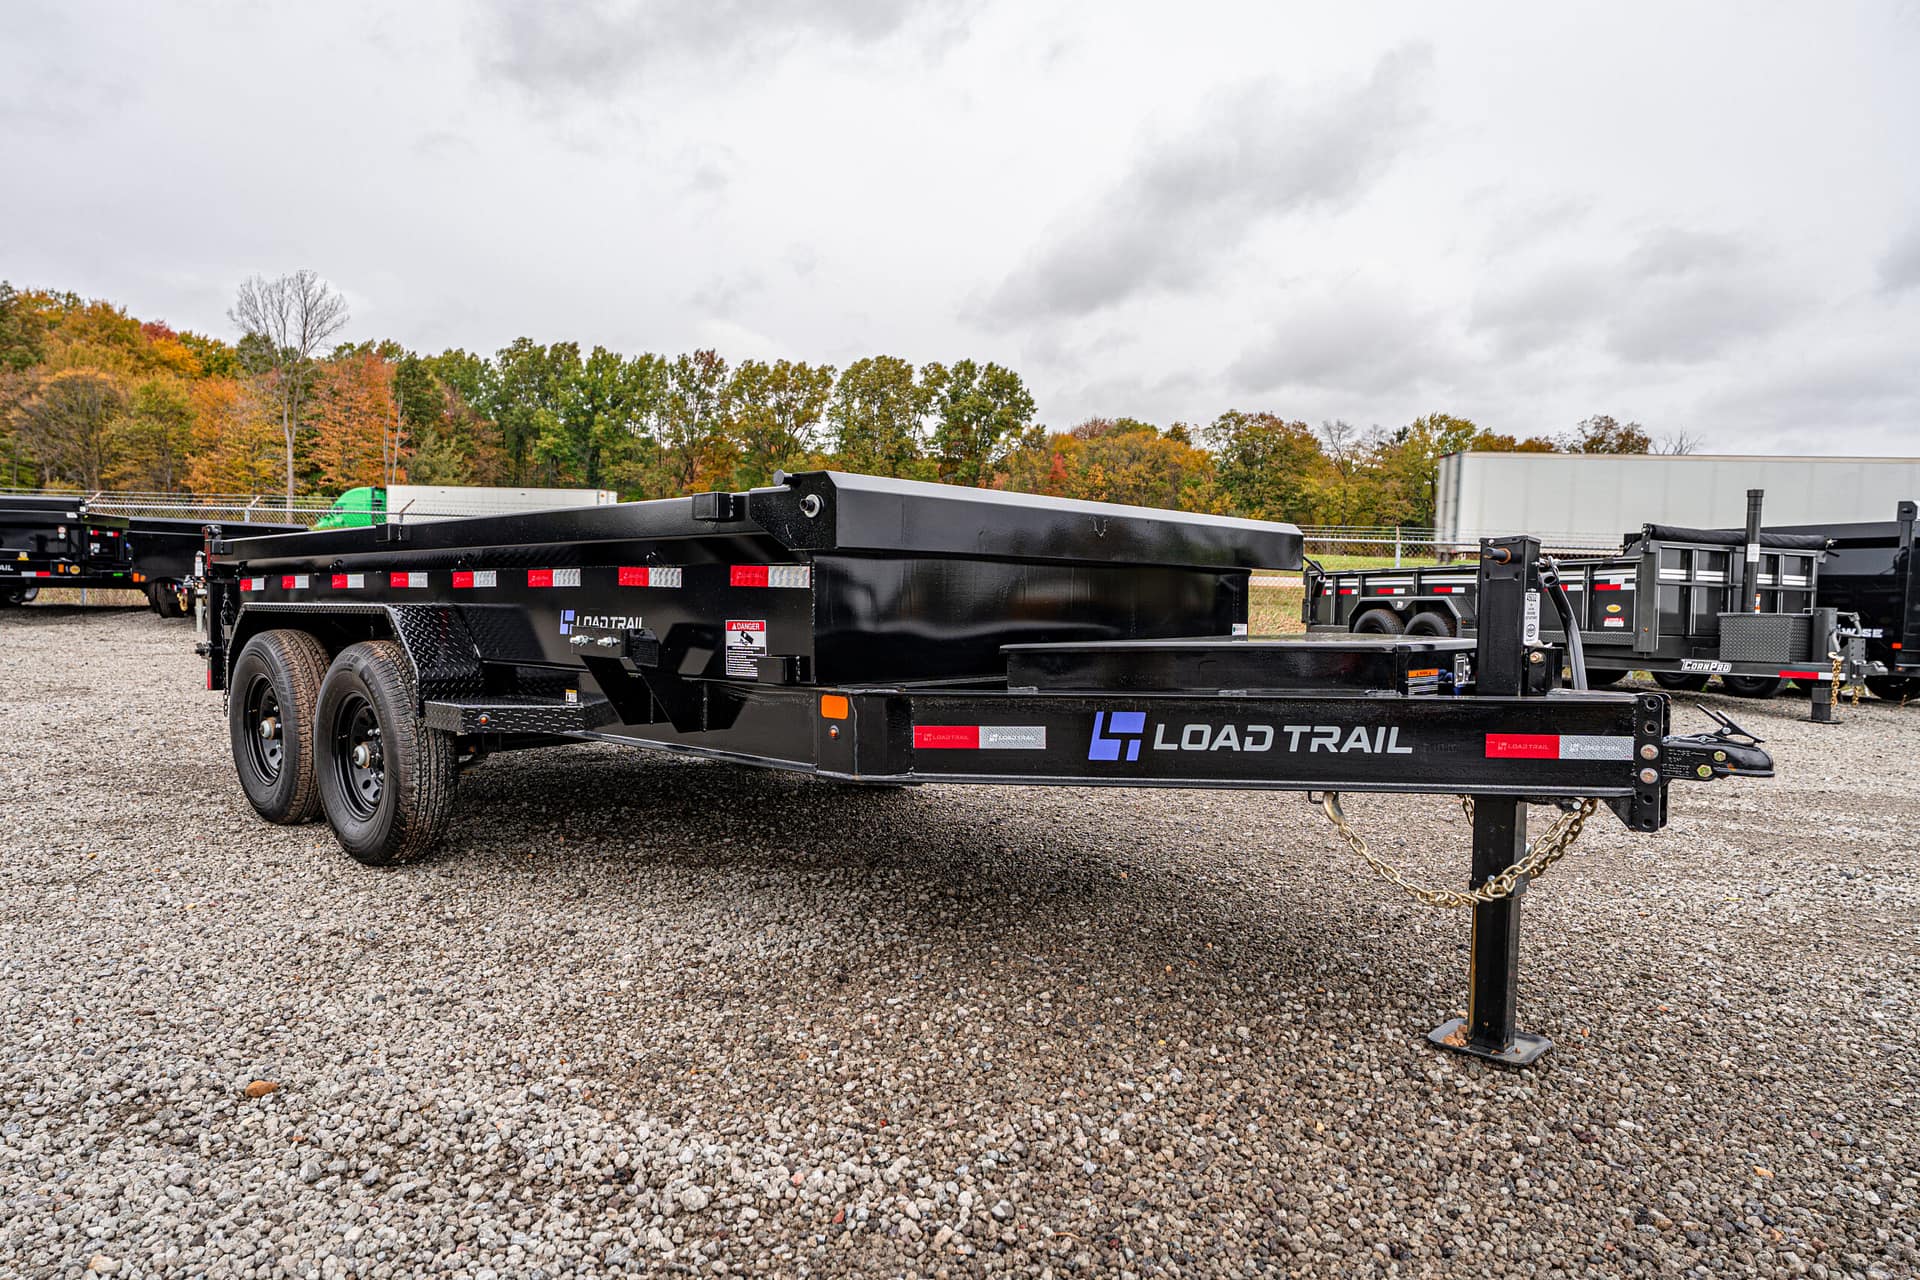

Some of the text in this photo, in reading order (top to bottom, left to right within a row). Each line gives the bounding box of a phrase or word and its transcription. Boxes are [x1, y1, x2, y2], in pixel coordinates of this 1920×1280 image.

[736, 622, 760, 630] DANGER
[1153, 723, 1413, 754] LOAD TRAIL
